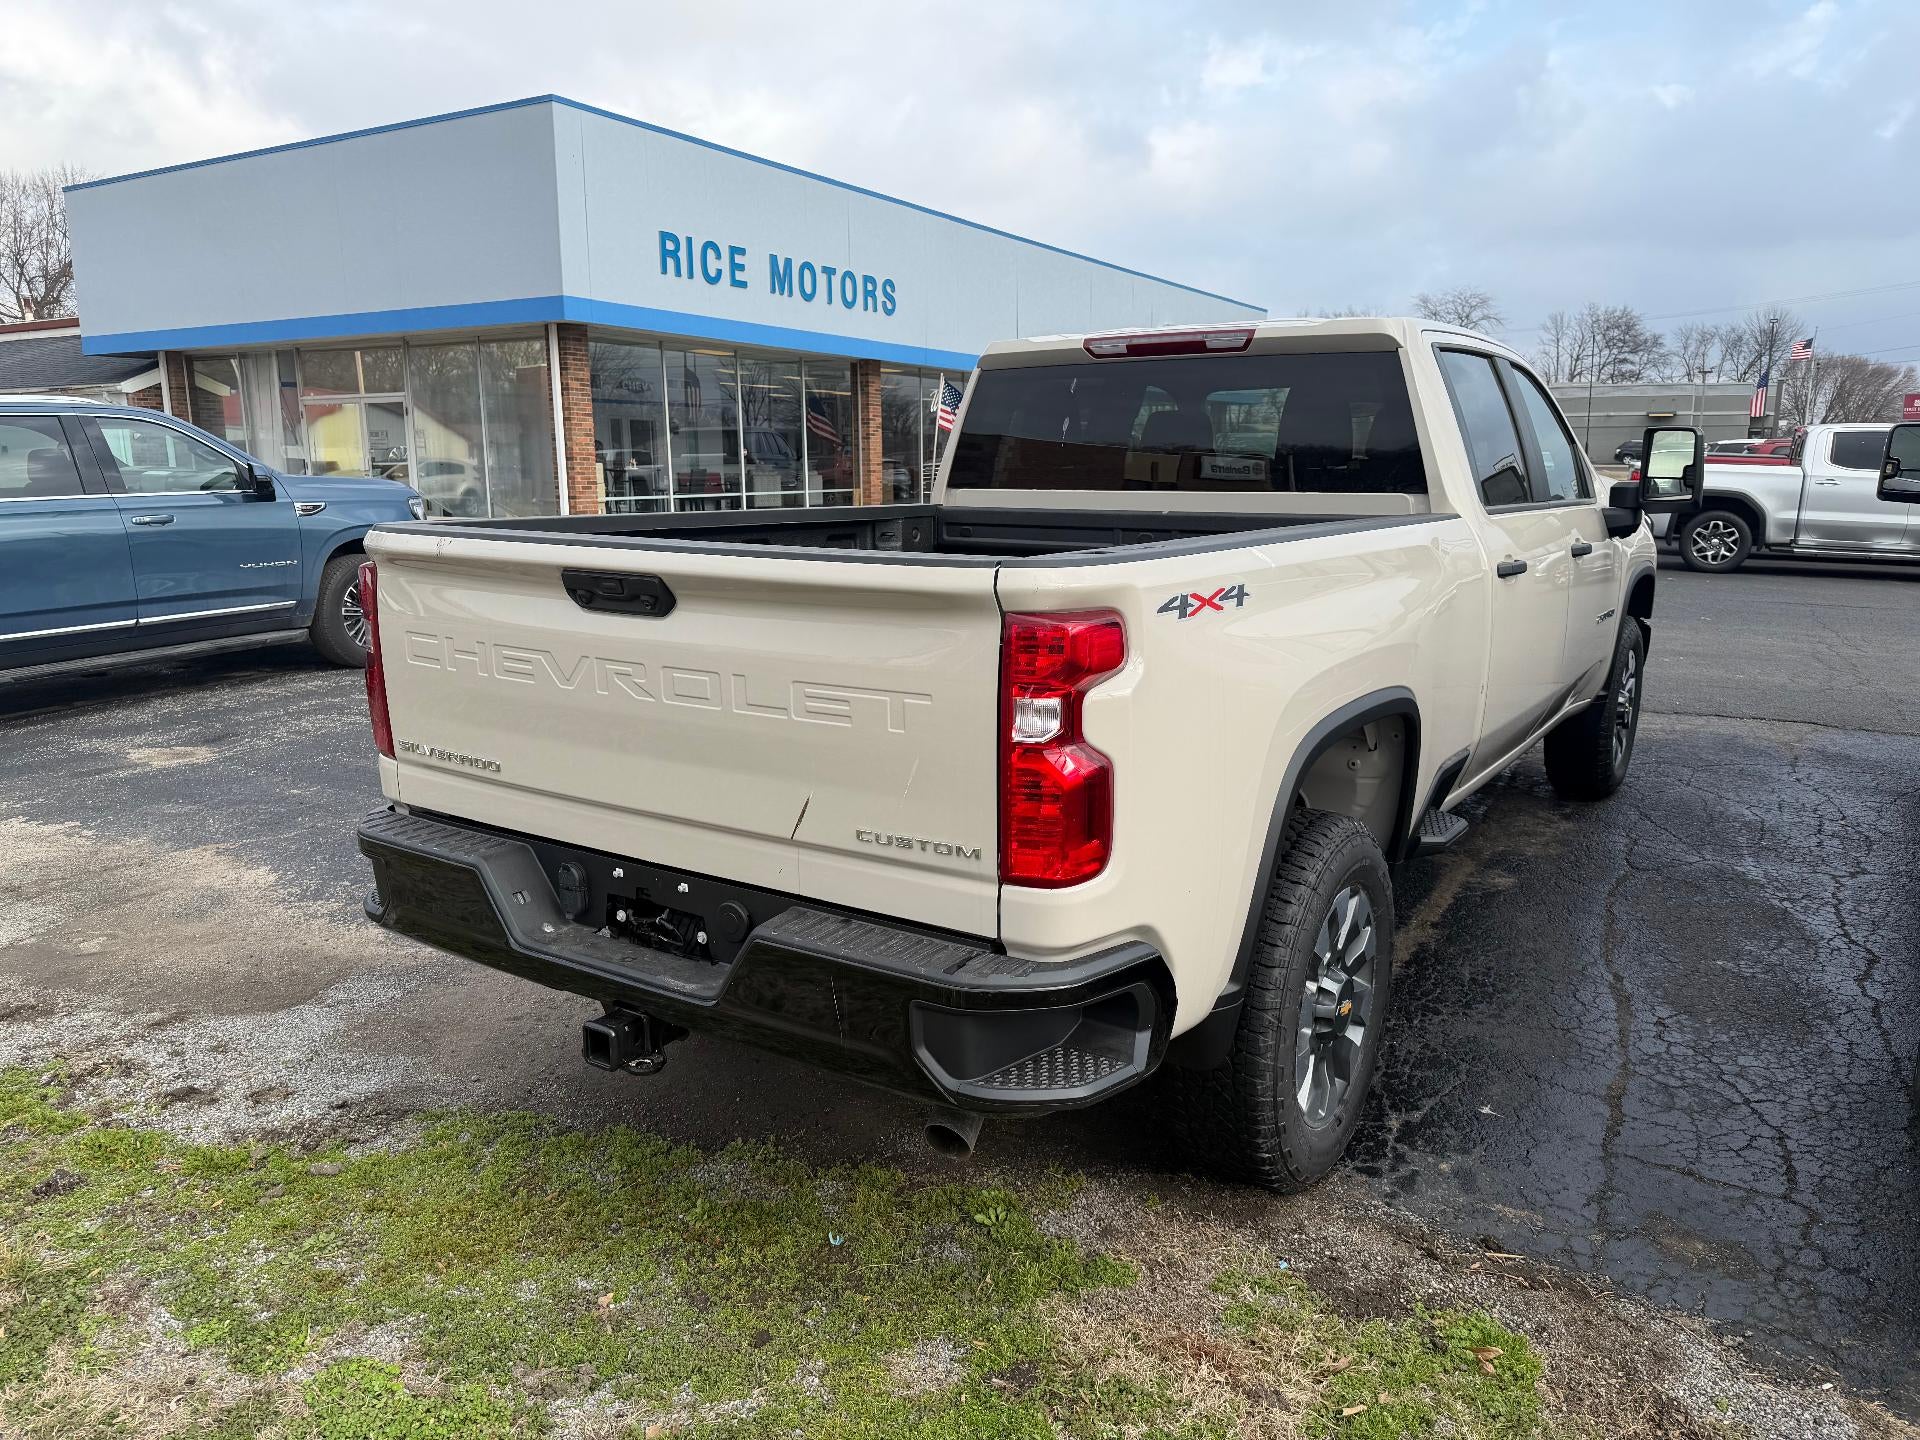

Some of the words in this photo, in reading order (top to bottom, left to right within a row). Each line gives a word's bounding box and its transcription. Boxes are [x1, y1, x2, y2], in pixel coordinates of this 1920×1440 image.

[658, 230, 748, 289] RICE
[768, 254, 897, 317] MOTORS
[240, 560, 298, 568] YUKON
[405, 630, 933, 733] CHEVROLET
[398, 739, 501, 773] SILVERADO
[856, 829, 982, 860] CUSTOM
